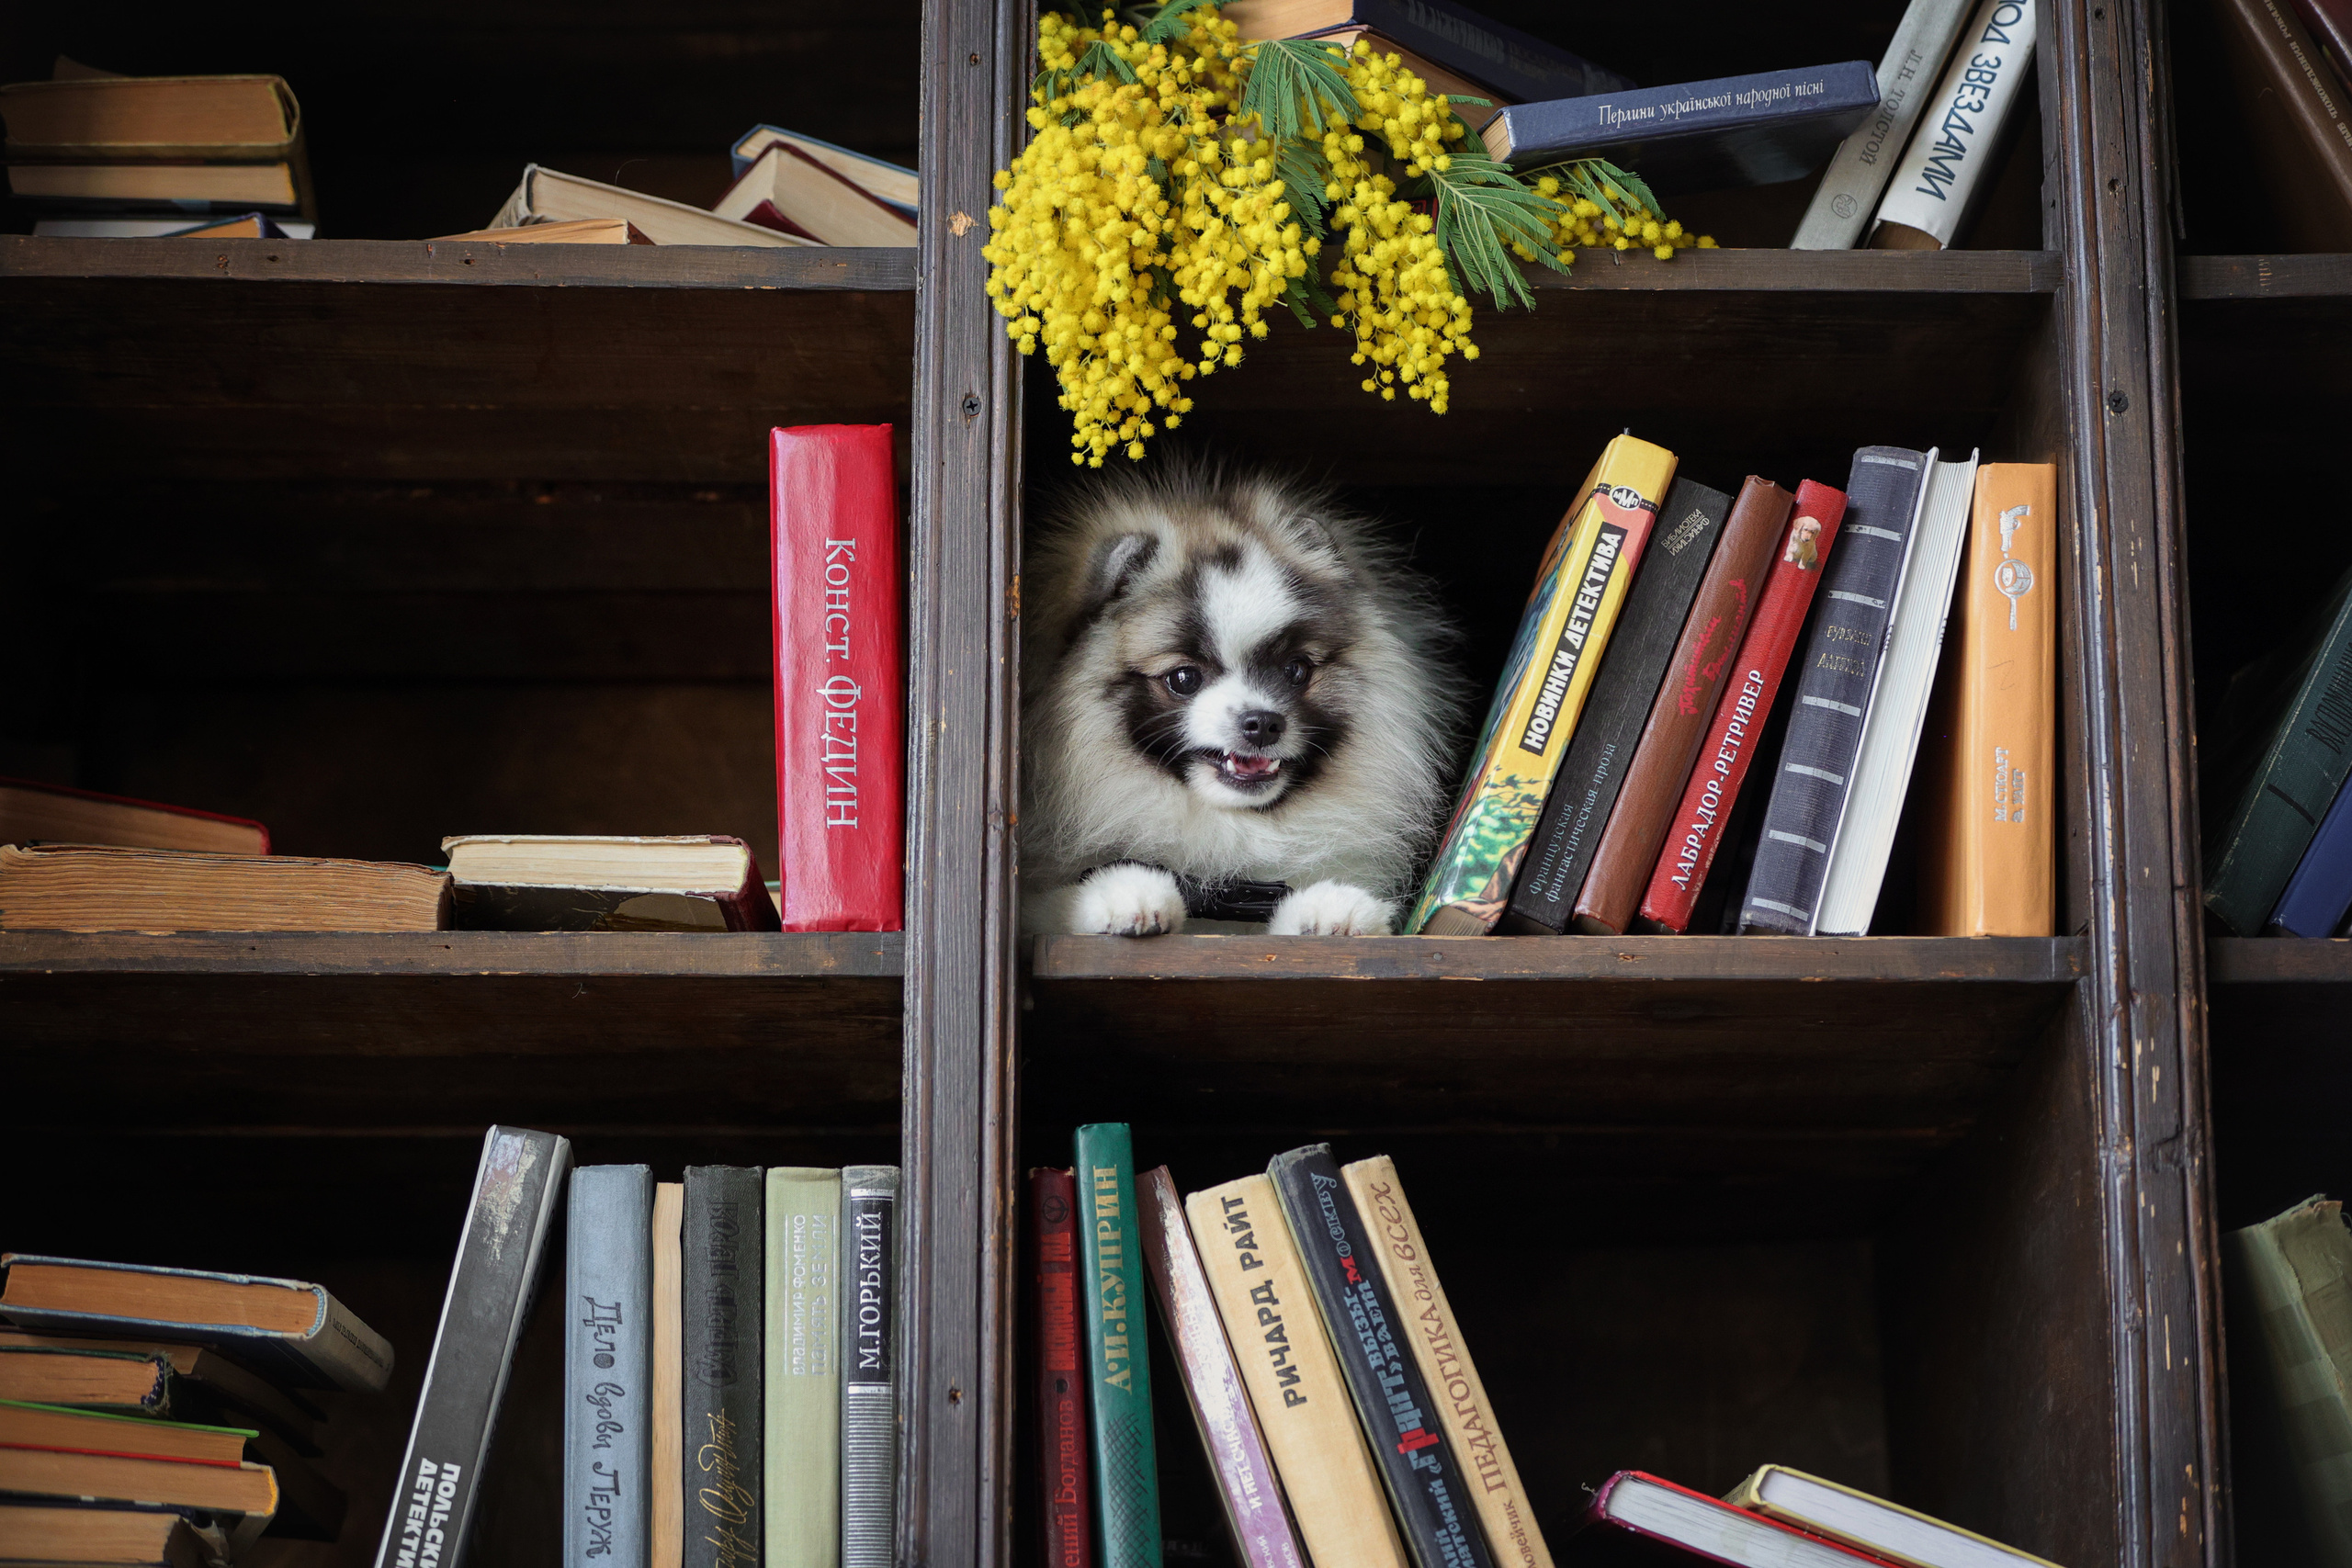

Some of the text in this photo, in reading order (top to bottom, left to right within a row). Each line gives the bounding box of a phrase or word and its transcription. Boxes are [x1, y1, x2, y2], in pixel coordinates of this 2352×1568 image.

[1599, 79, 1825, 129] Перлини української народної пісні
[1859, 89, 1905, 167] ТОЛСТОЙ
[1916, 0, 2026, 201] ОД ЗВЕЗДАМИ
[1661, 508, 1702, 548] БИБЛИОТЕКА
[1668, 517, 1710, 557] ФАНТАСТИКИ
[1524, 532, 1623, 750] НОВИНКИ ДЕТЕКТИВА
[816, 674, 862, 829] ФЕДИН
[1671, 669, 1764, 891] ЛАБРАДОР-РЕТРИВЕР
[1529, 803, 1574, 895] Французская
[1545, 743, 1617, 903] фантастическая проза
[792, 1213, 807, 1288] ФОМЕНКО
[810, 1213, 827, 1287] ЗЕМЛИ
[1408, 1264, 1433, 1302] для
[1037, 1232, 1076, 1371] ВИСОКОСНЫЙ ГОД
[1220, 1196, 1307, 1408] РИЧАРД РАЙТ
[586, 1381, 626, 1450] вдовы
[1419, 1302, 1508, 1495] ПЕДАГОГИКА
[396, 1458, 438, 1568] ДЕТЕКТИ
[1055, 1398, 1080, 1568] ений Богданов
[1237, 1465, 1258, 1495] НЕТ
[1256, 1535, 1275, 1568] ВСКИЙ
